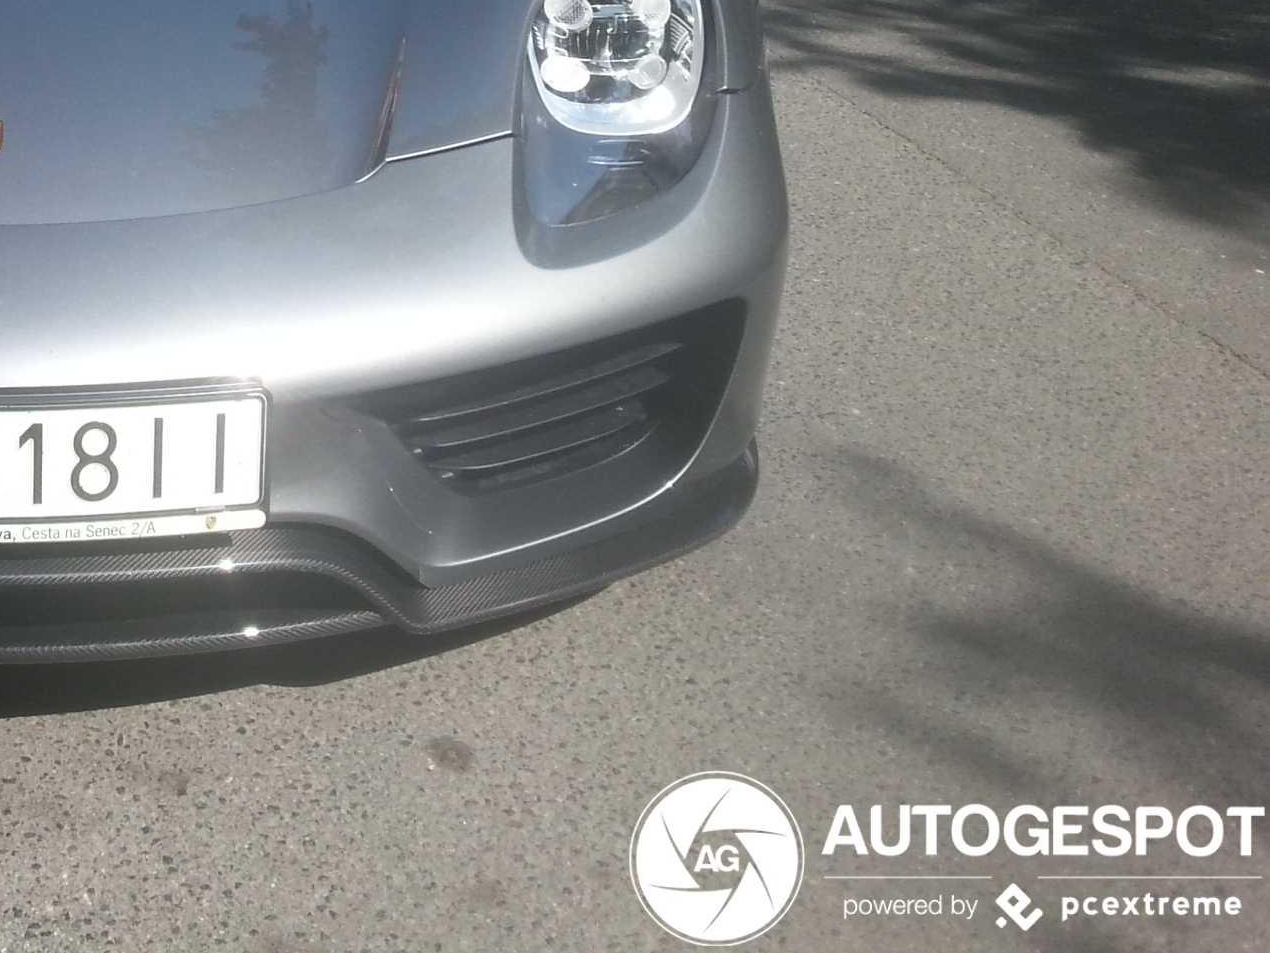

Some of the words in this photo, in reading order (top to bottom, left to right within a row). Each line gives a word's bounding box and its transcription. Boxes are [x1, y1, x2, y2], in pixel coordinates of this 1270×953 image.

[22, 526, 61, 540] Cesta
[65, 528, 81, 539] na
[86, 523, 126, 538] Senec
[131, 521, 156, 538] 2/A
